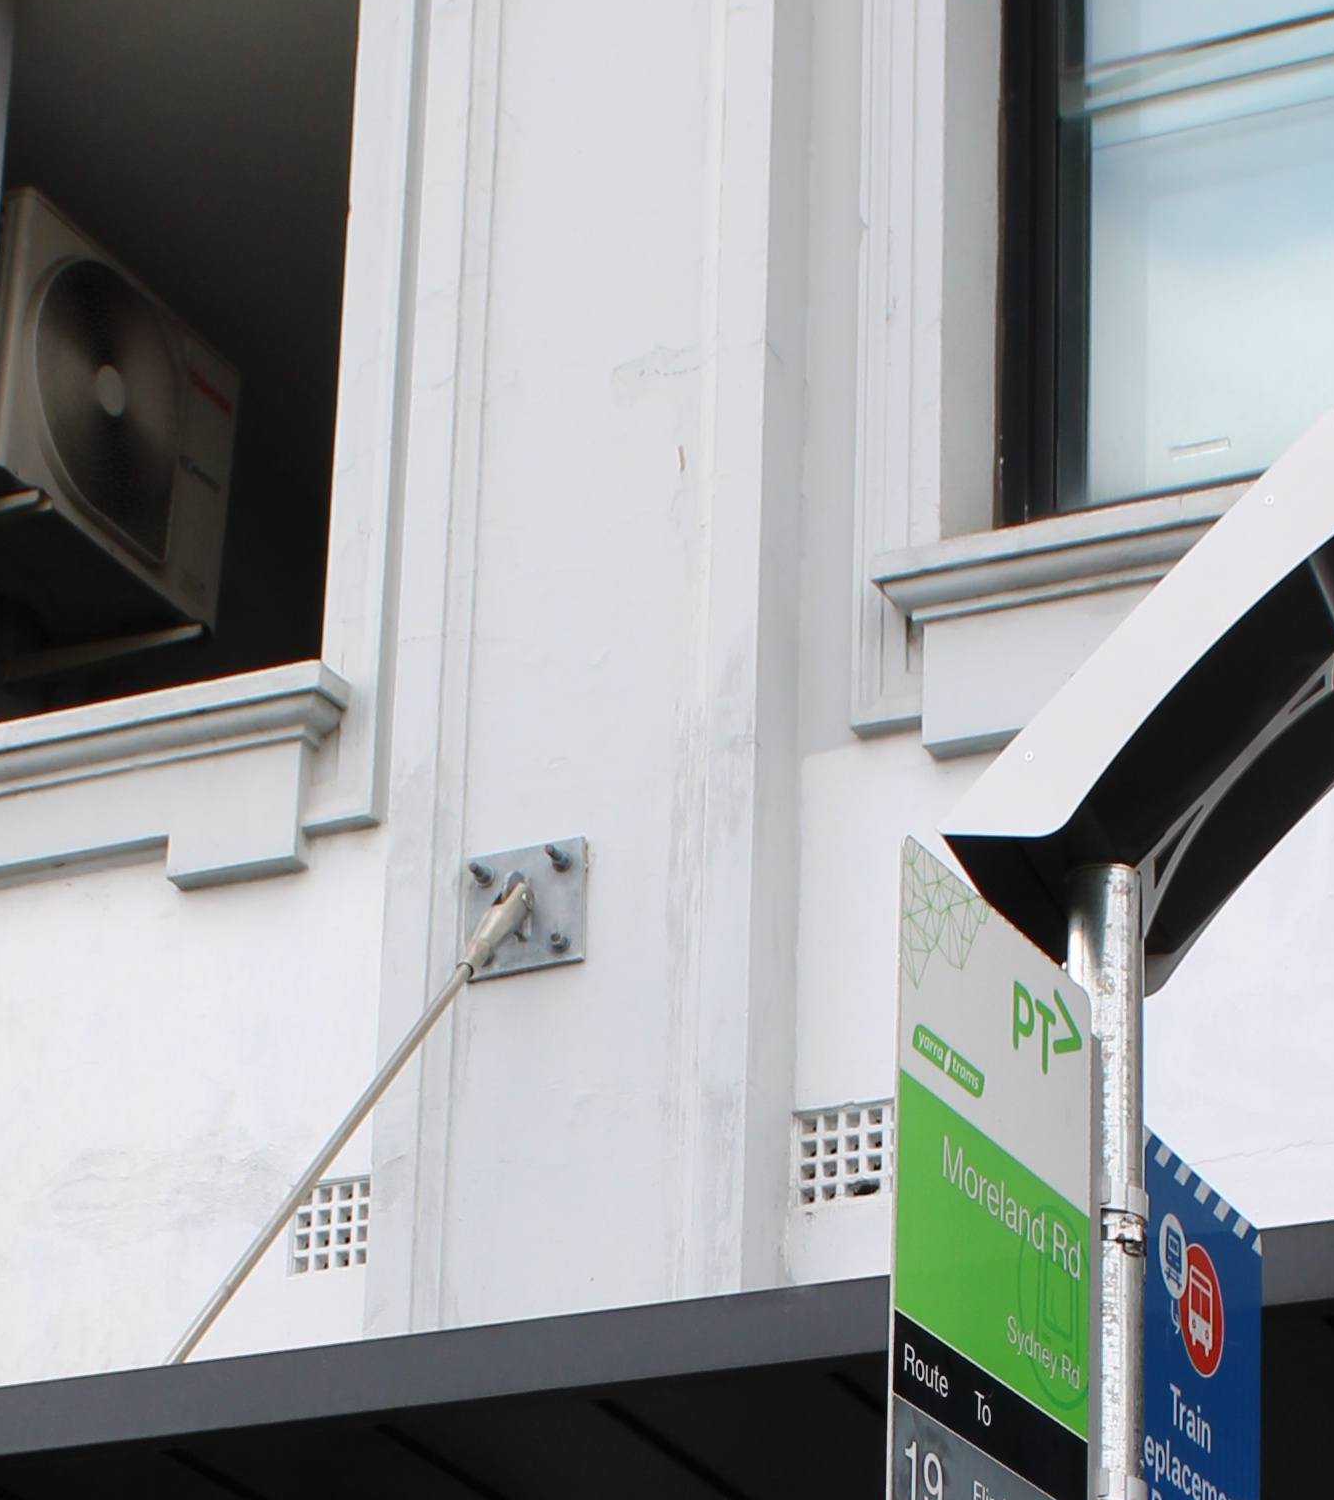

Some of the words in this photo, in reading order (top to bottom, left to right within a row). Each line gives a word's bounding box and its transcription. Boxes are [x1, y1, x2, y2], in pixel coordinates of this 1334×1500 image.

[917, 1029, 944, 1062] yarra
[952, 1060, 980, 1090] trams
[942, 1134, 1045, 1253] Moreland
[1052, 1220, 1082, 1282] Rd
[903, 1342, 949, 1398] Route
[974, 1390, 993, 1427] To
[1005, 1314, 1058, 1384] Sydney
[1060, 1347, 1082, 1391] Rd
[1169, 1382, 1213, 1454] Train
